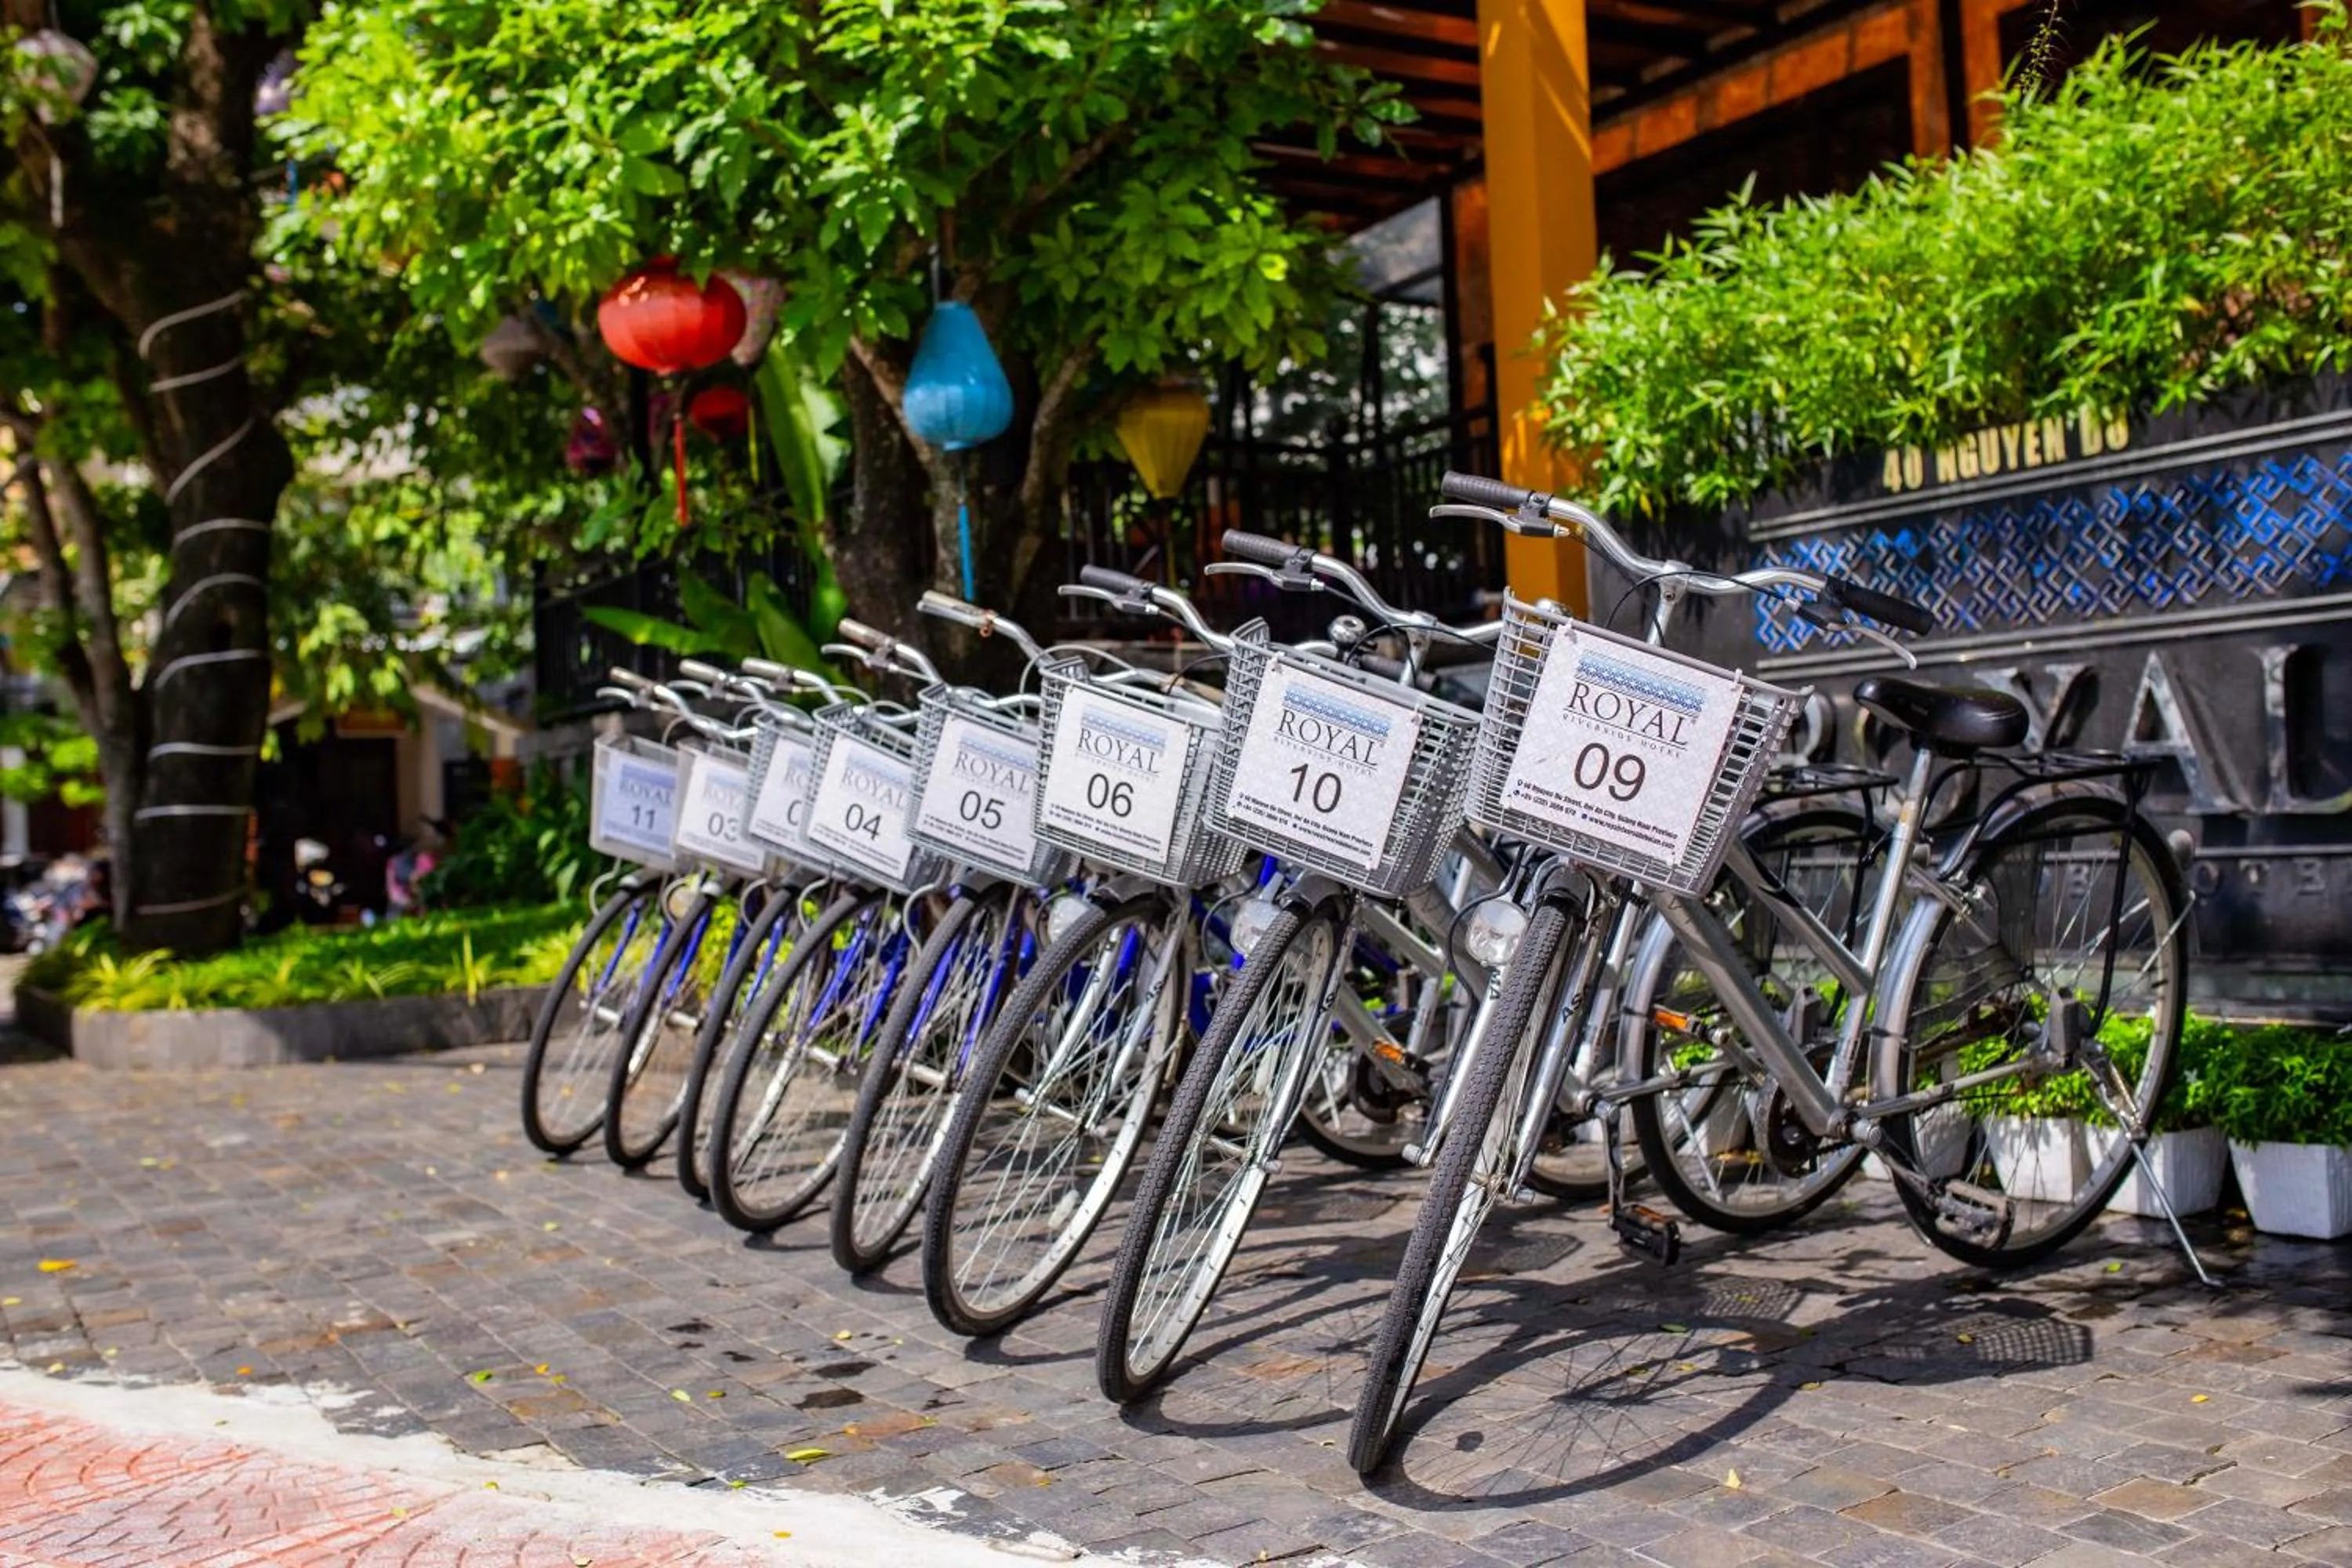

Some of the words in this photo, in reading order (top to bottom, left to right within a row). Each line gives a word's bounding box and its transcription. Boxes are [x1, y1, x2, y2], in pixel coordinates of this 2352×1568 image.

[1883, 444, 1923, 494] 40
[1936, 416, 2067, 484] NGUYEN
[1568, 681, 1688, 745] ROYAL
[1078, 728, 1160, 774] ROYAL
[1277, 710, 1377, 766] ROYAL
[840, 767, 904, 811] ROYAL
[955, 750, 1029, 794] ROYAL
[1290, 762, 1341, 814] 10
[1573, 742, 1646, 802] 09
[632, 804, 655, 829] 11
[960, 790, 1005, 830] 05
[1087, 773, 1134, 818] 06
[707, 811, 739, 842] 03
[846, 803, 881, 841] 04
